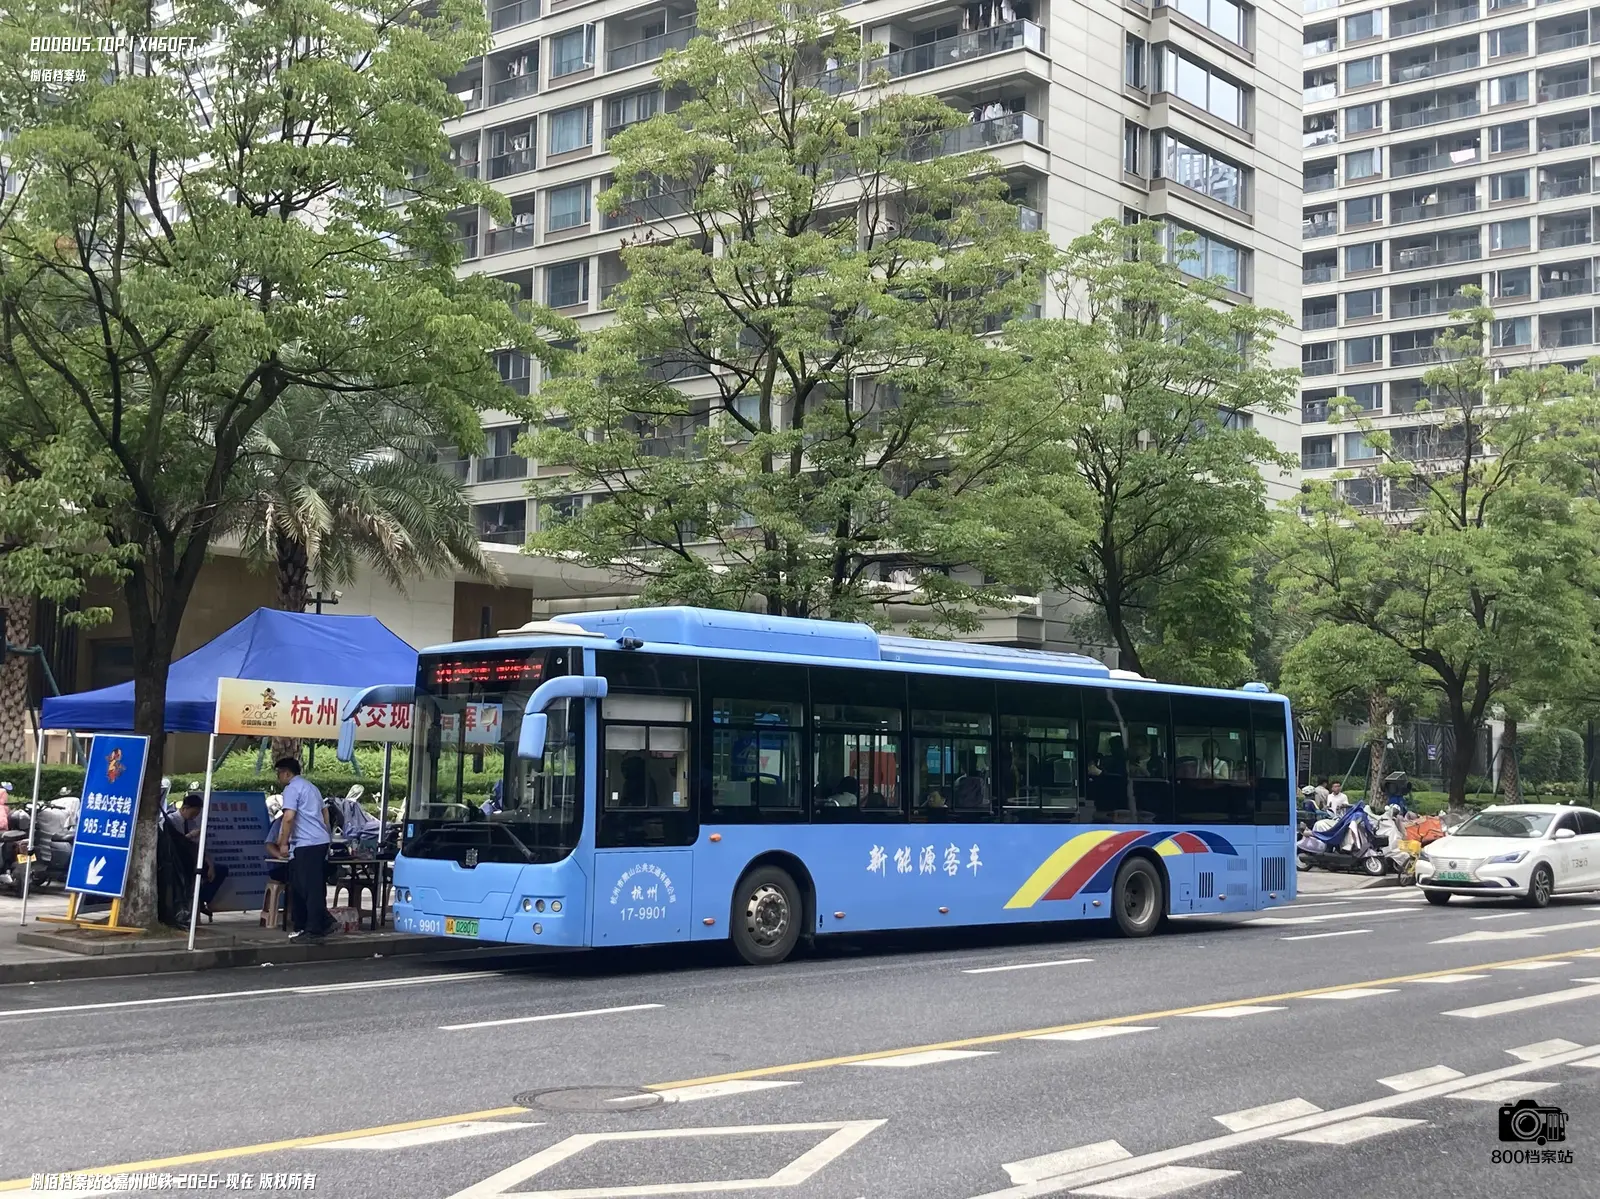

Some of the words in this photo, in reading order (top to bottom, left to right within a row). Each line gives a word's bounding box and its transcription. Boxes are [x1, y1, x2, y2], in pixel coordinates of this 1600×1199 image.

[86, 791, 132, 815] 免费公交专线
[866, 842, 983, 878] 新能源客车
[630, 883, 659, 902] 杭州
[620, 906, 667, 921] 17-9901
[403, 918, 441, 932] 17-9901
